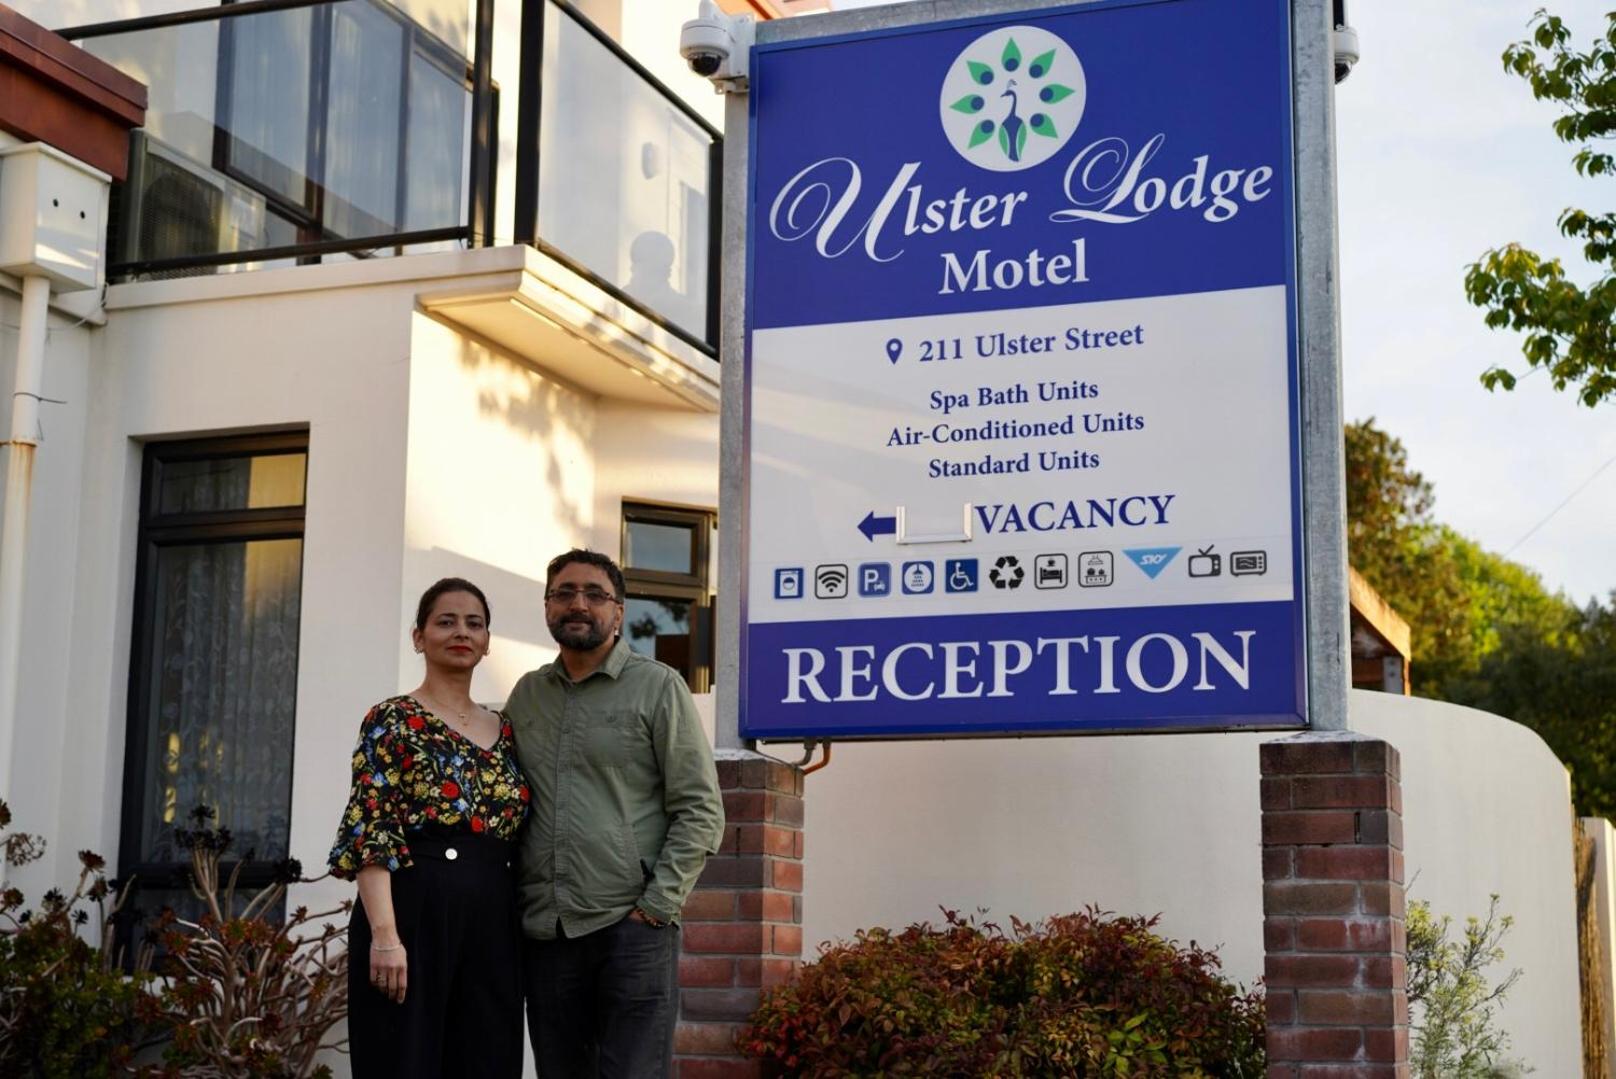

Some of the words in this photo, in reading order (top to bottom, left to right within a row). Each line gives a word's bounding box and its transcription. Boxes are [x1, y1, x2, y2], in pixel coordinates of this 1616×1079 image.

[769, 157, 1028, 262] Ulster
[1049, 133, 1273, 224] Lodge
[938, 237, 1090, 295] Motel
[918, 338, 965, 363] 211
[975, 331, 1057, 359] Ulster
[1065, 324, 1144, 351] Street
[929, 389, 970, 413] Spa
[977, 384, 1029, 406] Bath
[1038, 380, 1099, 402] Units
[886, 415, 1074, 447] Air-Conditioned
[1082, 412, 1145, 435] Units
[928, 453, 1030, 479] Standard
[1038, 450, 1100, 472] Units
[974, 494, 1177, 535] VACANCY
[780, 630, 1257, 704] RECEPTION
